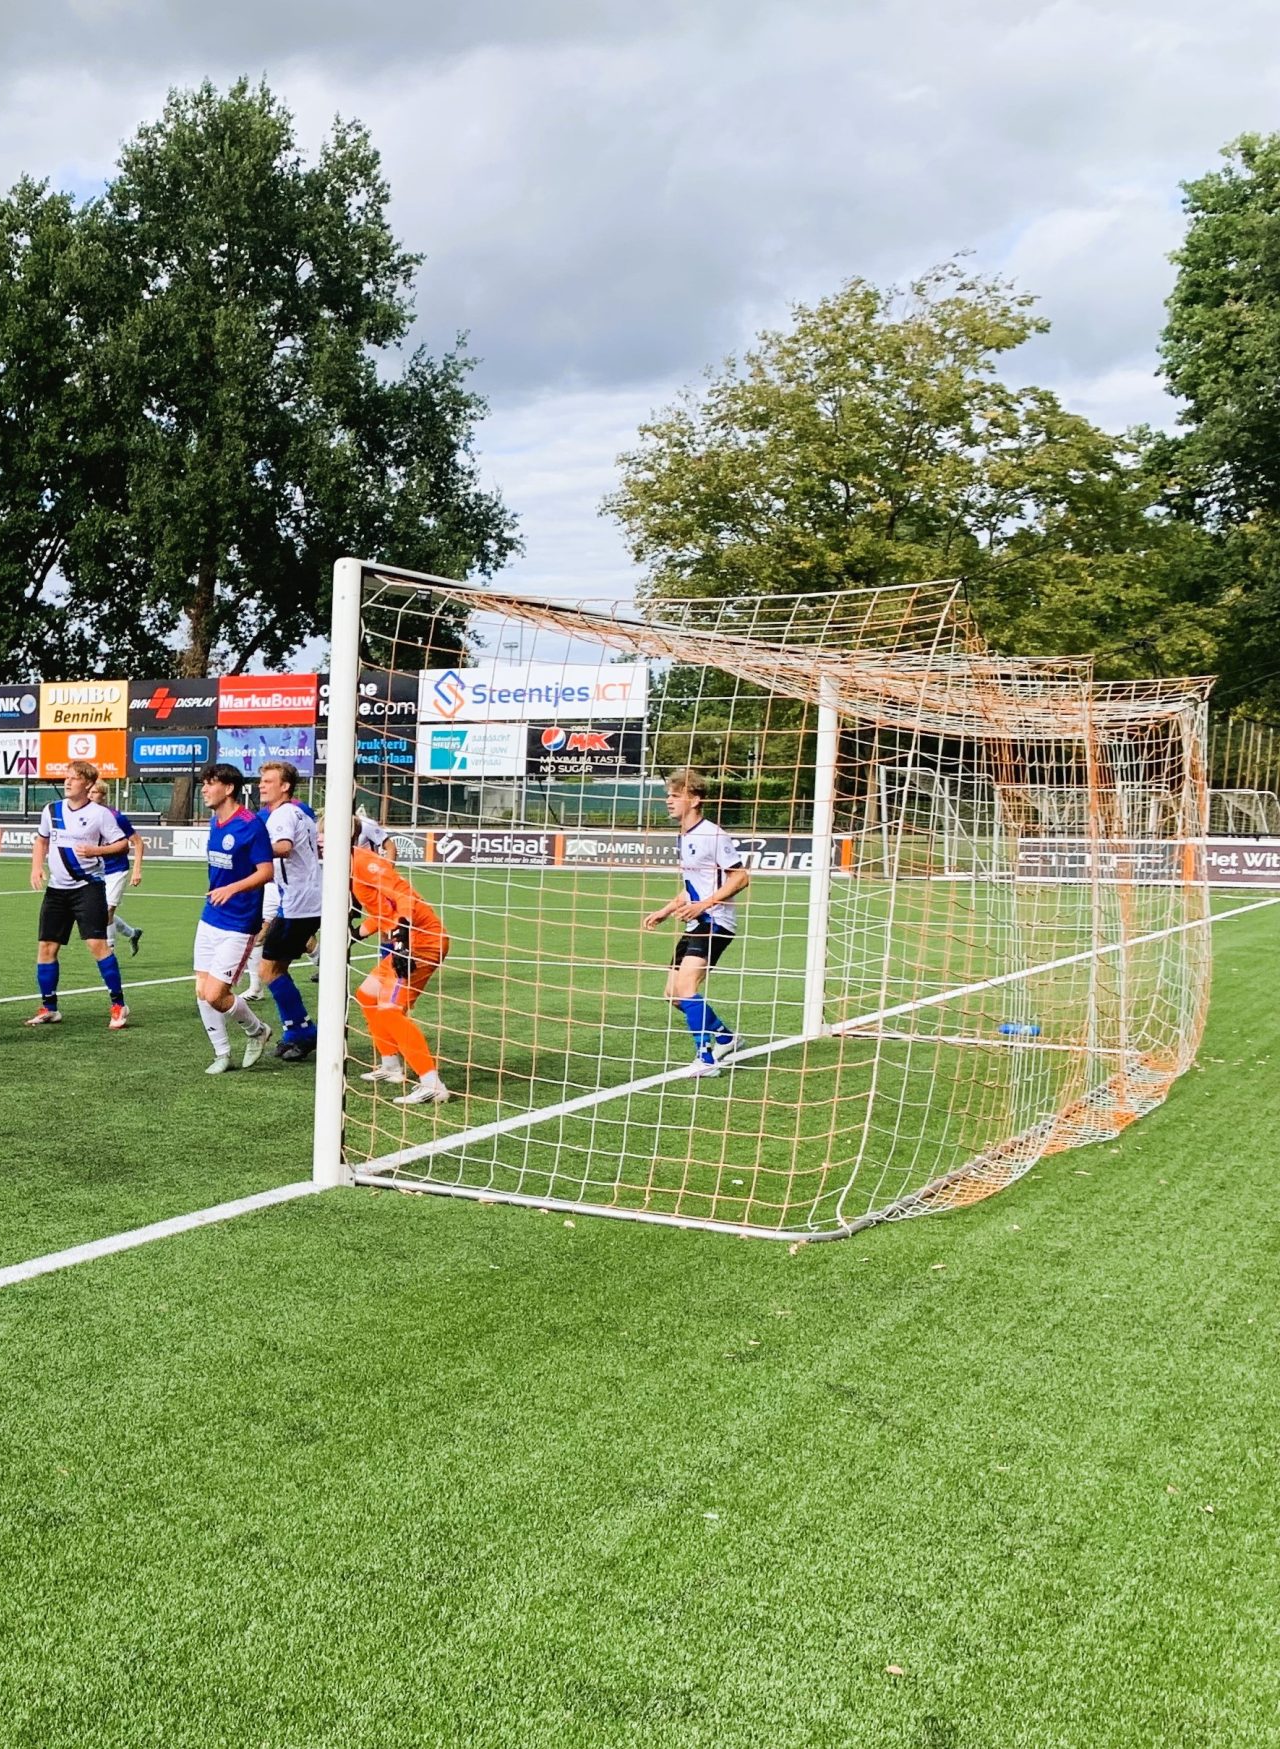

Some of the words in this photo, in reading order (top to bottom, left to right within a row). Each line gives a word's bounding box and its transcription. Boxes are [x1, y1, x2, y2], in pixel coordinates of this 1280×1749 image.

[48, 686, 121, 705] JUMBO
[220, 693, 315, 709] MarkuBouw
[472, 682, 589, 708] Steentjes
[595, 683, 632, 701] ICT
[129, 698, 151, 709] BVH
[175, 697, 217, 707] DISPLAY
[54, 708, 112, 723] Bennink
[140, 744, 202, 756] EVENTBAR
[219, 747, 256, 757] Siebert
[259, 747, 266, 757] &
[268, 746, 312, 757] Wassink
[540, 756, 591, 764] MAXIMUM
[594, 756, 627, 764] TASTE
[540, 765, 556, 773] NO
[558, 765, 593, 773] SUGAR
[471, 833, 549, 854] instaat
[597, 842, 645, 854] DAMEN
[646, 846, 680, 855] GIFT
[1205, 852, 1238, 866] Het
